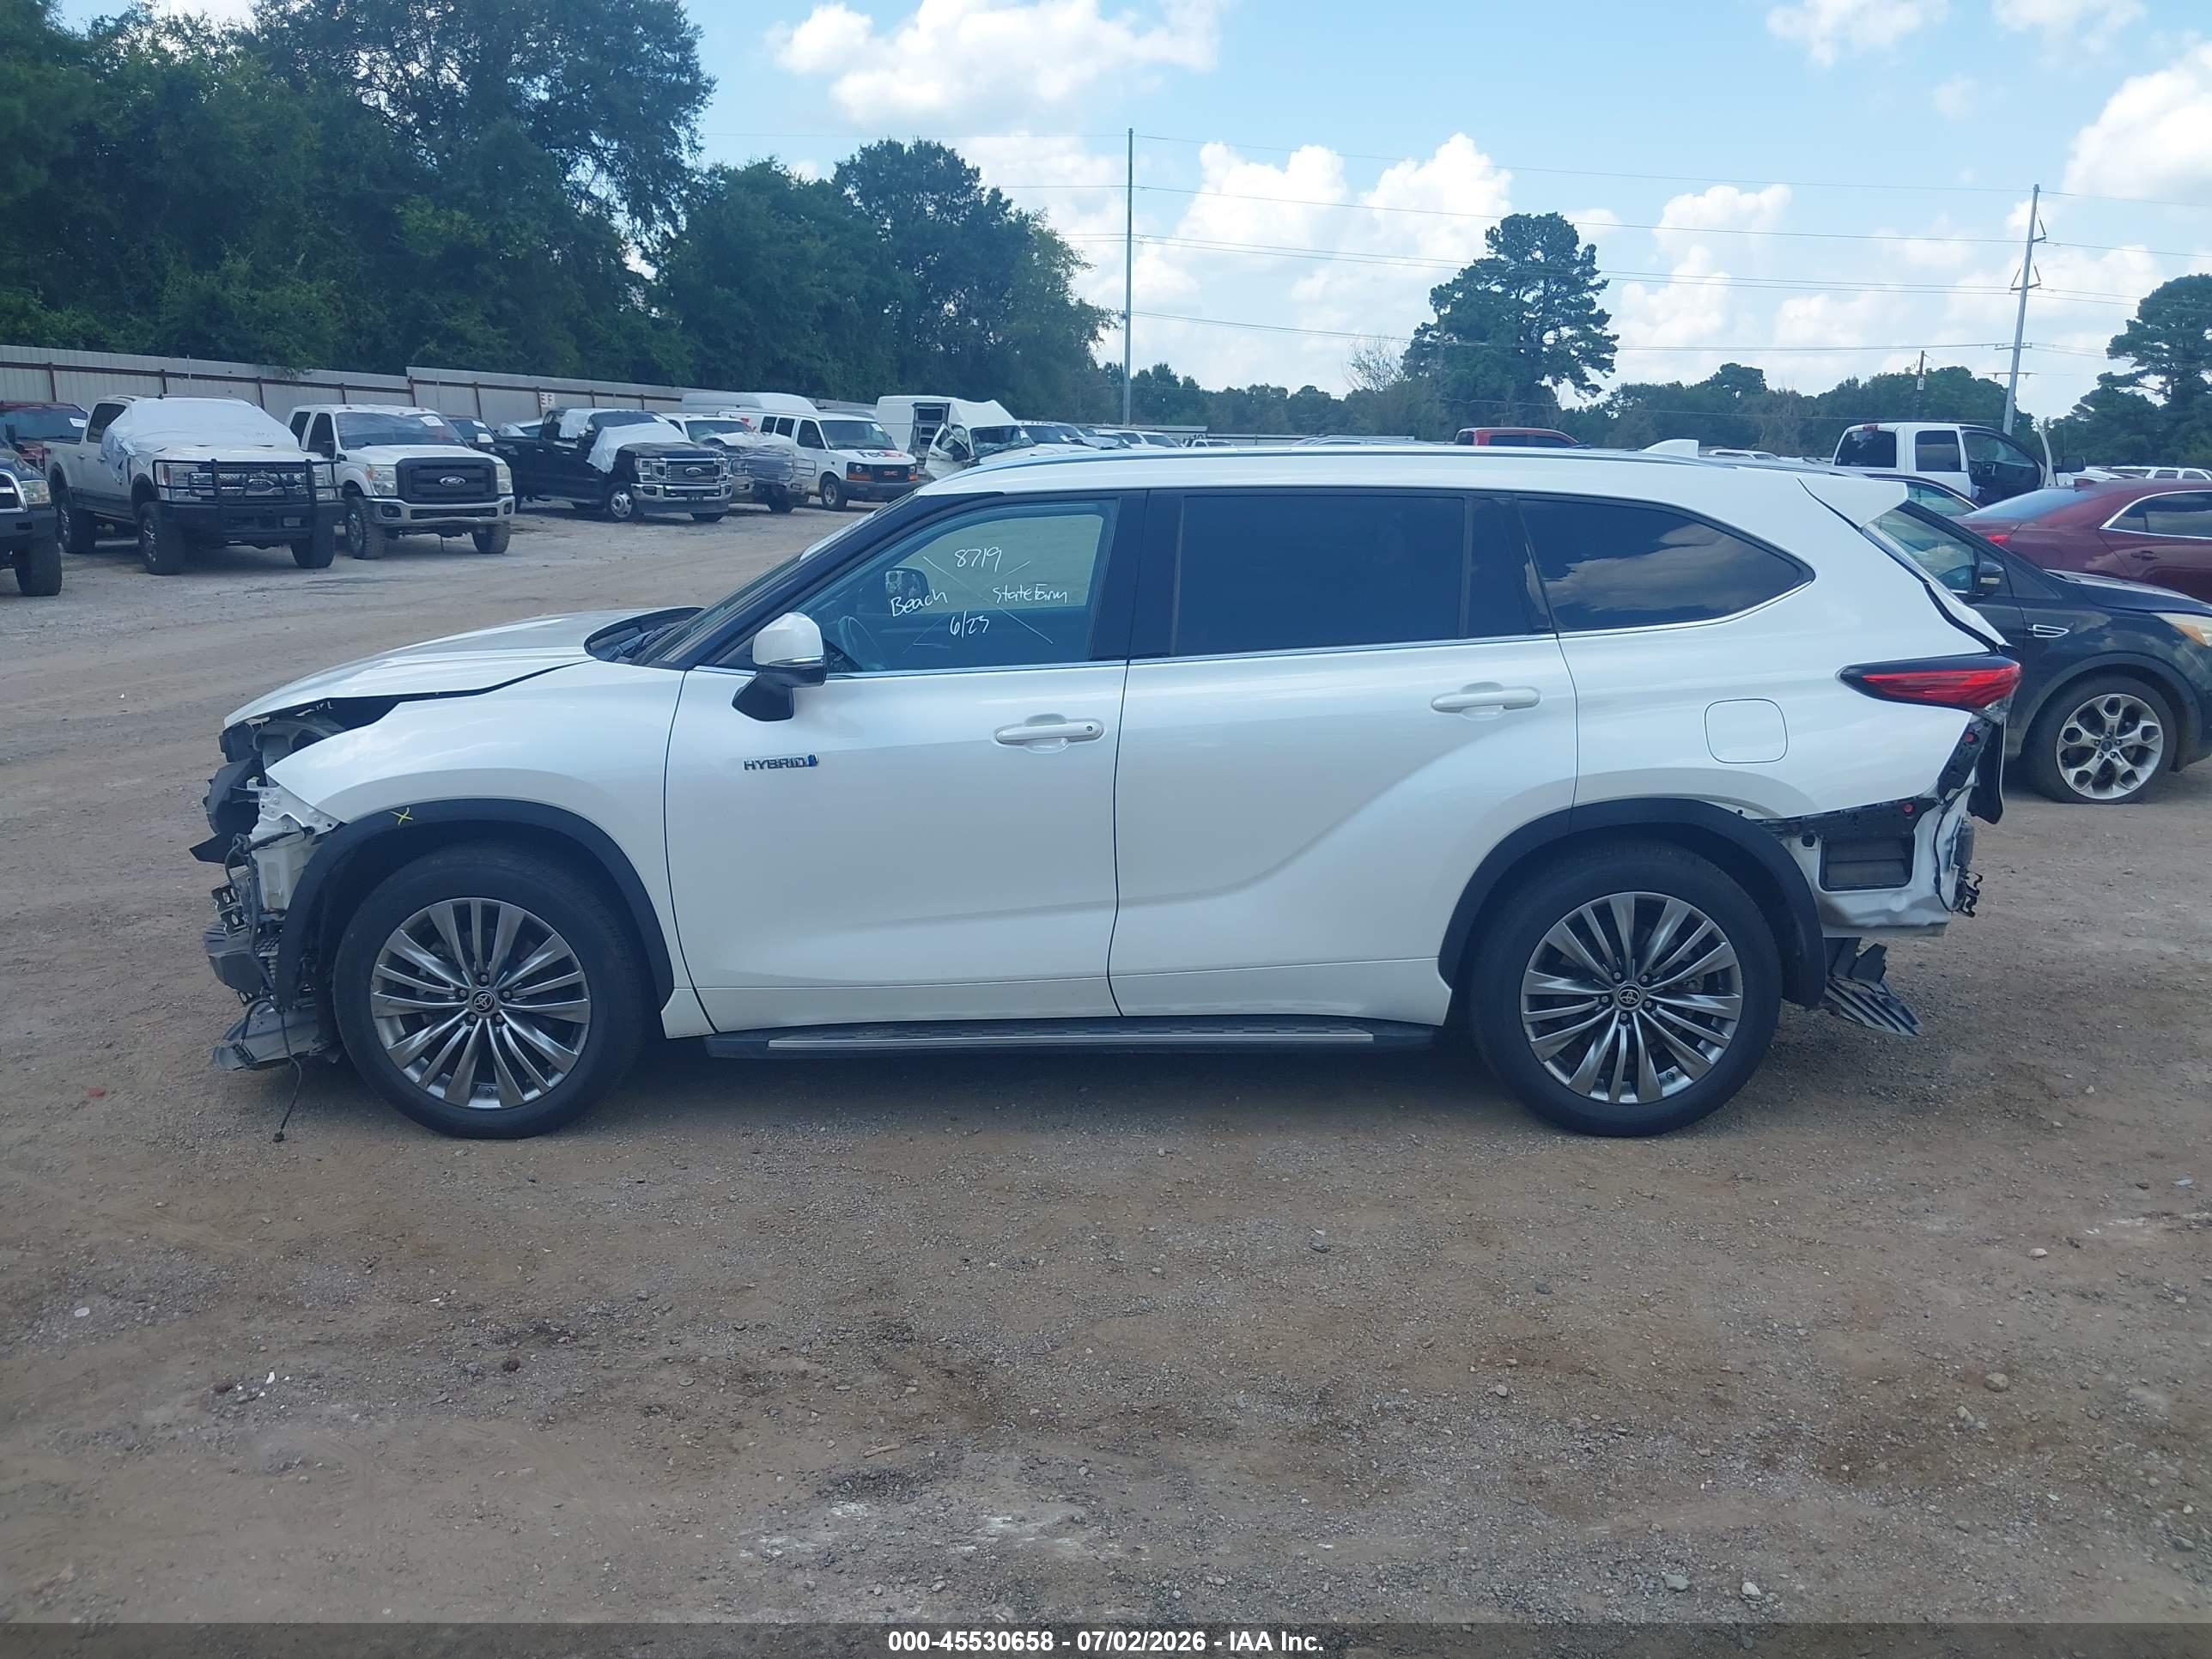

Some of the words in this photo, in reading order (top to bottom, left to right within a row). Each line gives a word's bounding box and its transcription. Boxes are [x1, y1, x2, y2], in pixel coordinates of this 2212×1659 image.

[954, 547, 1003, 573] 8719
[890, 588, 948, 617] Beach
[744, 757, 805, 770] HYBRID
